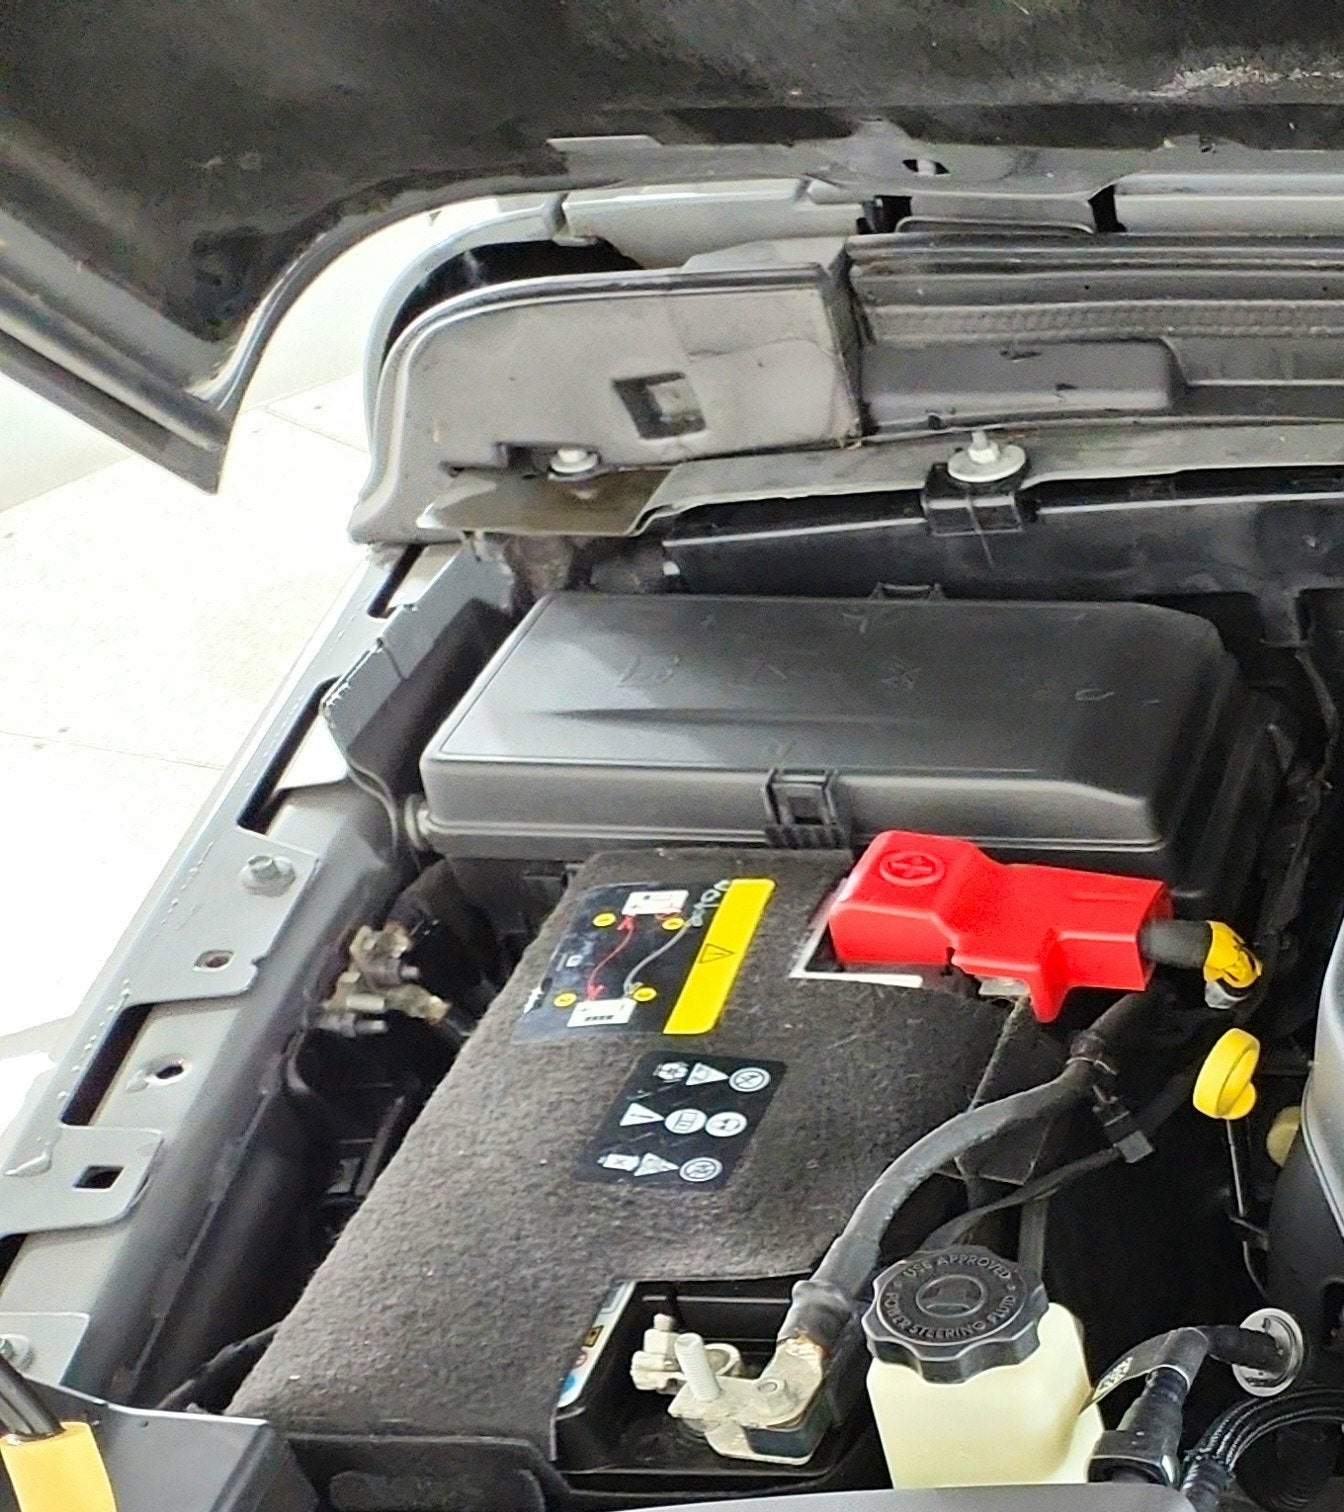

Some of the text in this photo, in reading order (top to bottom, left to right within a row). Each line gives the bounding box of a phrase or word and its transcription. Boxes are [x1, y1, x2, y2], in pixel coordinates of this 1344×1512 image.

[902, 1253, 1013, 1281] USE APPROVED
[883, 1291, 1017, 1341] POWER STEERING FLUID
